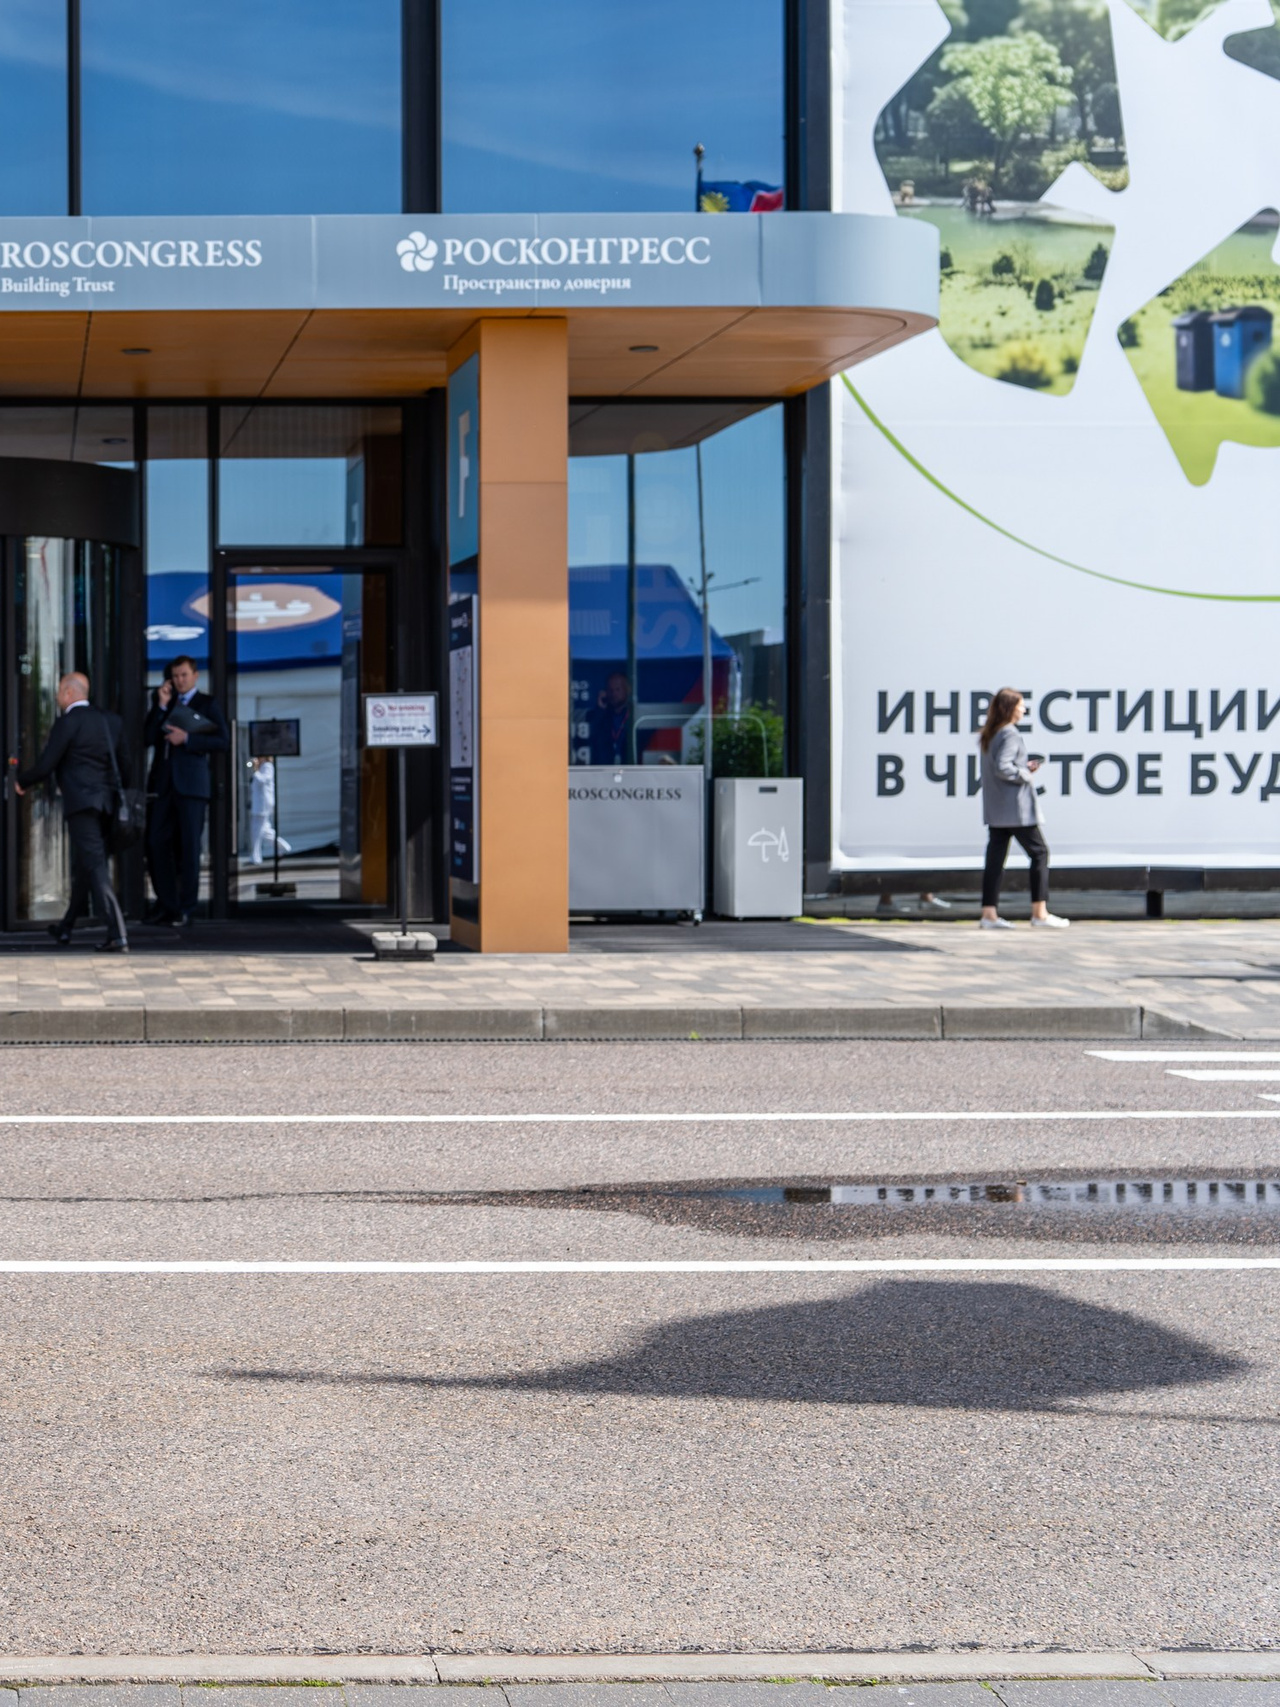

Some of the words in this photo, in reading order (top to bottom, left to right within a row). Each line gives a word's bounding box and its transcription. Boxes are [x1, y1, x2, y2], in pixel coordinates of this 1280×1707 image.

[0, 239, 262, 268] ROSCONGRESS
[443, 236, 711, 265] РОСКОНГРЕСС
[1, 276, 70, 297] Building
[72, 276, 115, 292] Trust
[443, 275, 562, 294] Пространство
[563, 278, 631, 294] доверия
[877, 753, 905, 797] В
[568, 787, 682, 801] ROSCONGRESS
